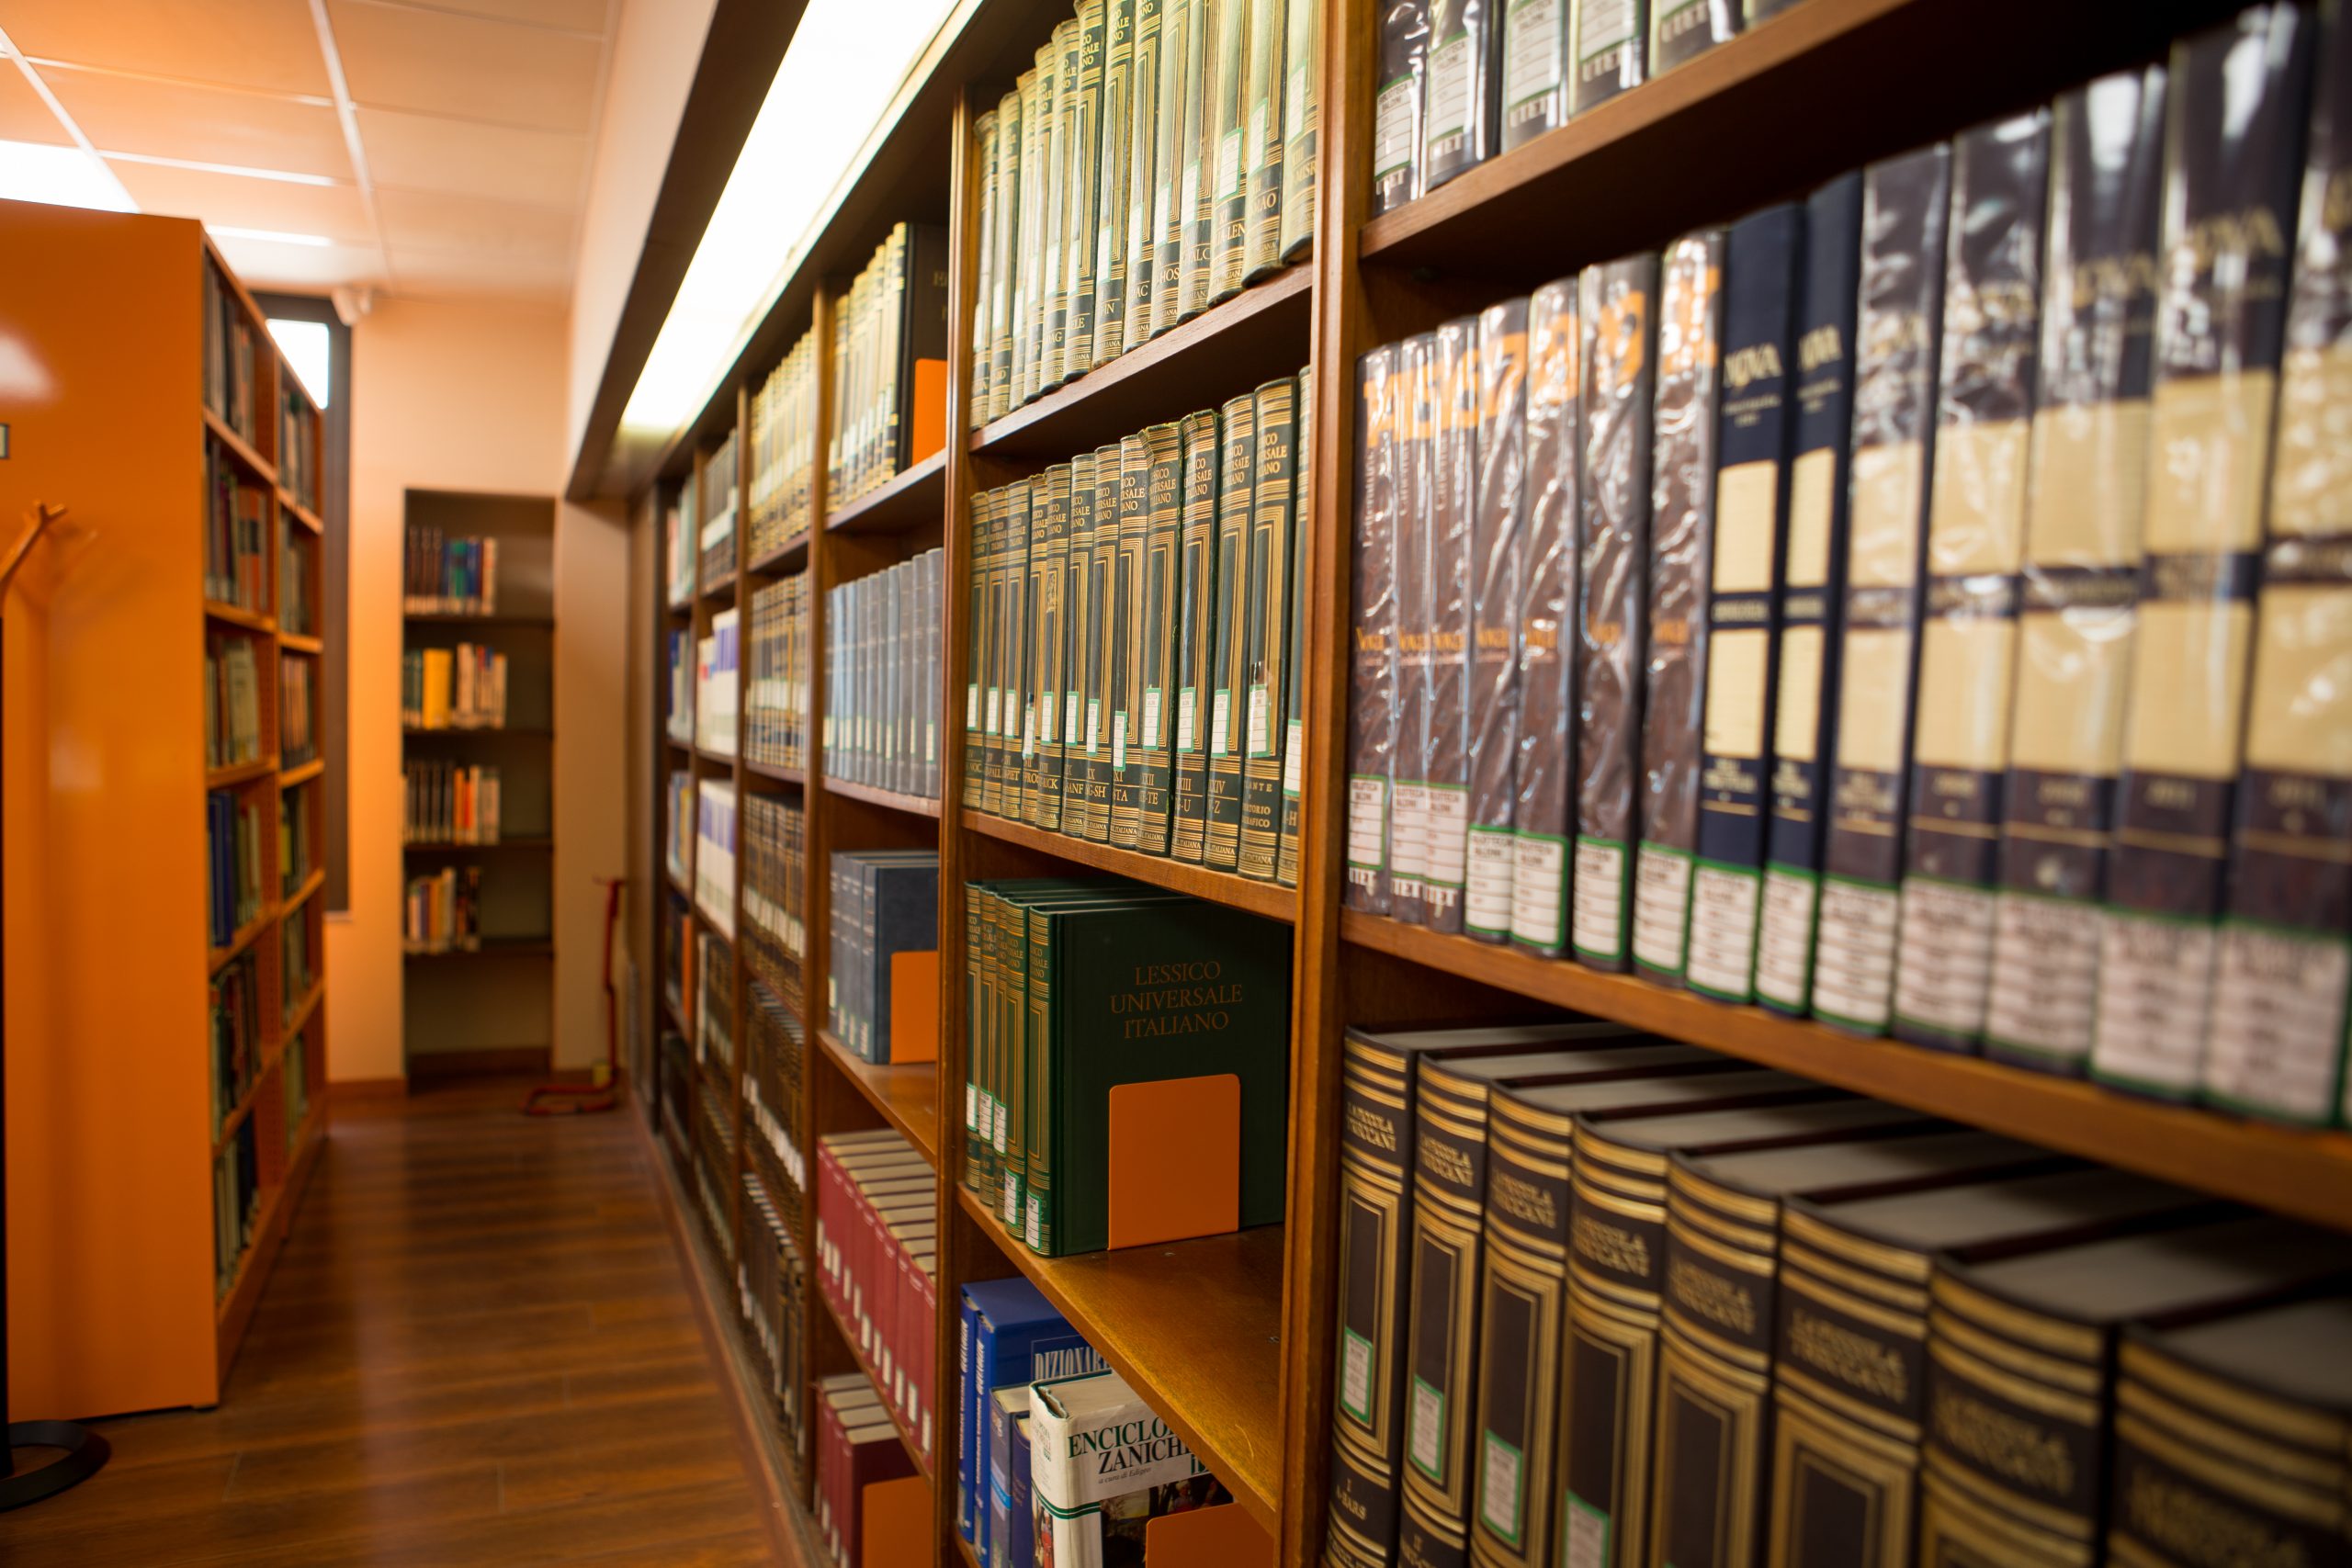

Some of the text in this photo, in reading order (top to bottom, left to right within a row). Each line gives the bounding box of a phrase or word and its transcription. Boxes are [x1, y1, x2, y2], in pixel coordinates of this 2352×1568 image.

[1134, 961, 1221, 986] LESSICO
[1110, 984, 1243, 1014] UNIVERSALE
[1124, 1010, 1229, 1039] ITALIANO
[1068, 1416, 1178, 1459] ENCICLO
[1098, 1437, 1192, 1474] ZANICH
